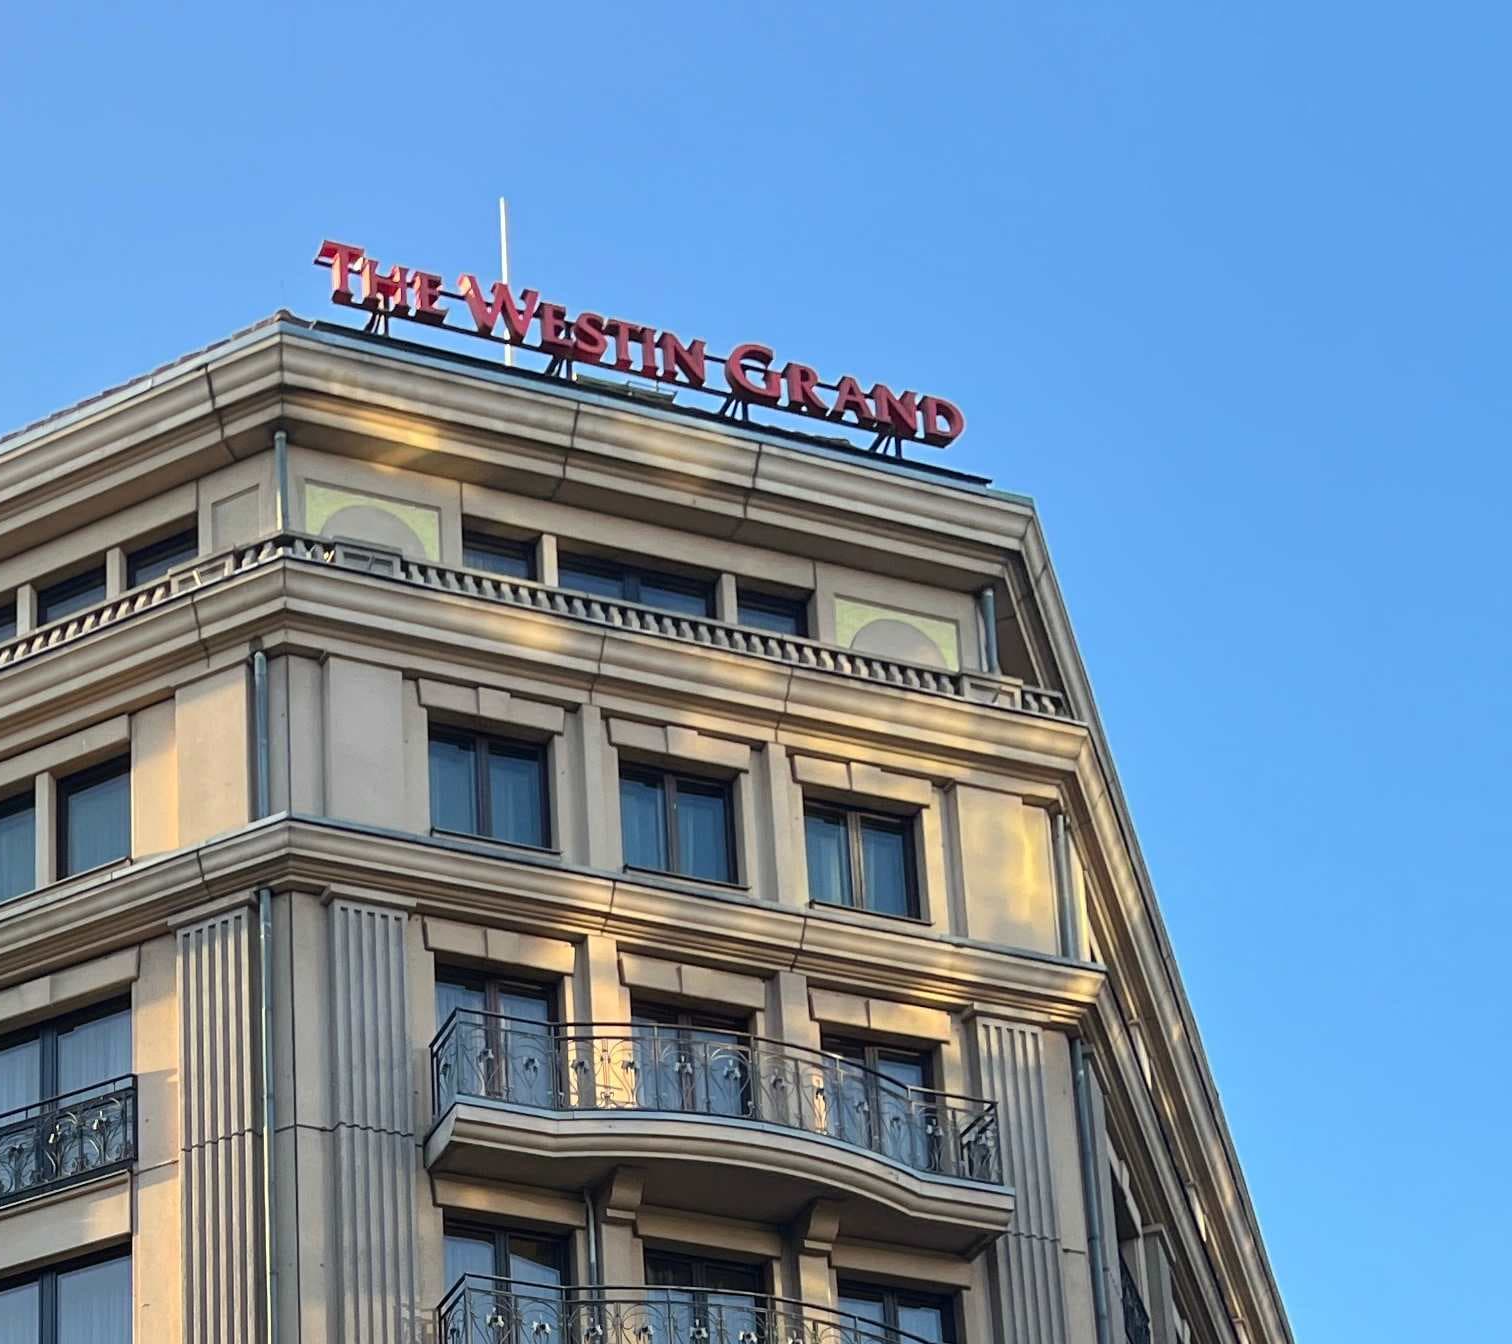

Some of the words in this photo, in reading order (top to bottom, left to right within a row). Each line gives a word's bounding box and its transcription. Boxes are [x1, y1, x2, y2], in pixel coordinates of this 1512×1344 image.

[314, 239, 449, 325] THE
[457, 273, 706, 387] WESTIN
[724, 343, 966, 449] GRAND
